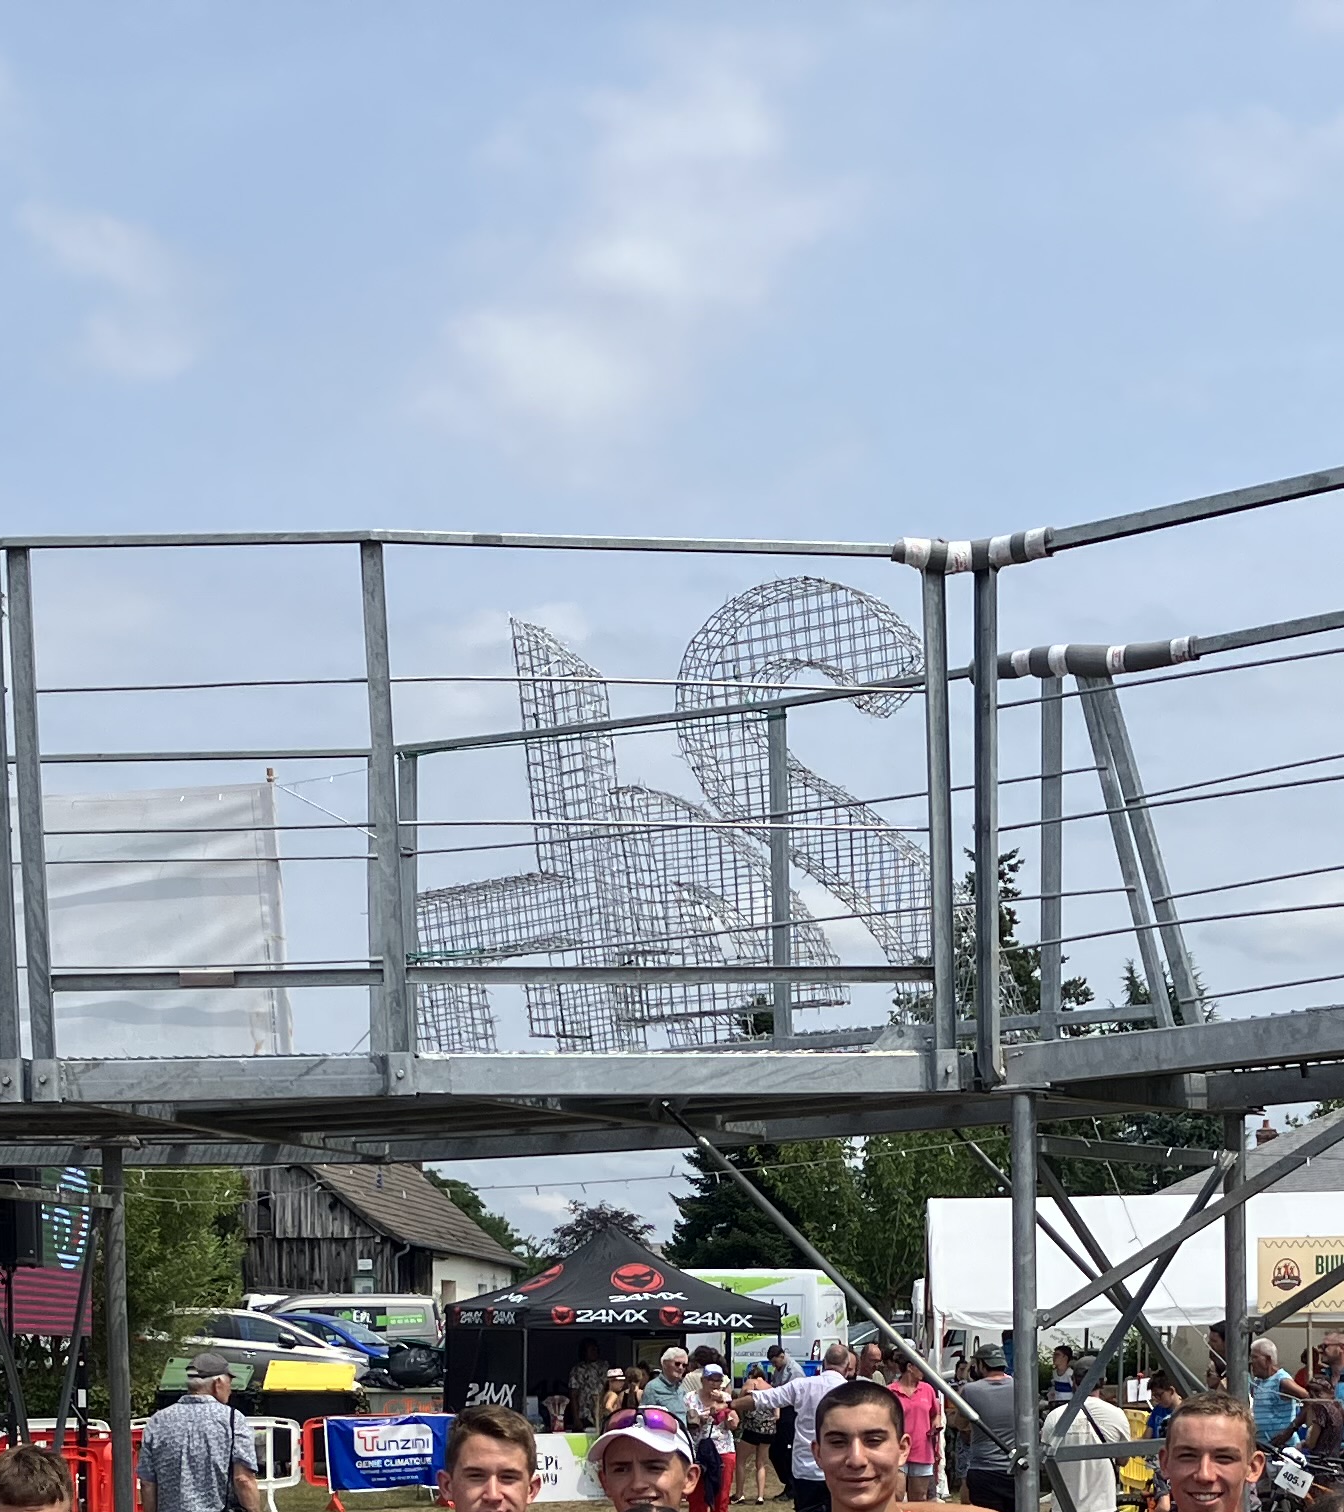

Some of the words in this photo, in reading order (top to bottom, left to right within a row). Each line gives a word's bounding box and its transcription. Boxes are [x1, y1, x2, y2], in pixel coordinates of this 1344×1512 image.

[575, 1309, 649, 1324] 24MX
[683, 1310, 754, 1329] 24MX
[356, 1459, 382, 1469] GENIE
[384, 1457, 432, 1467] CLIMATIQUE
[1283, 1471, 1306, 1489] 405.1
